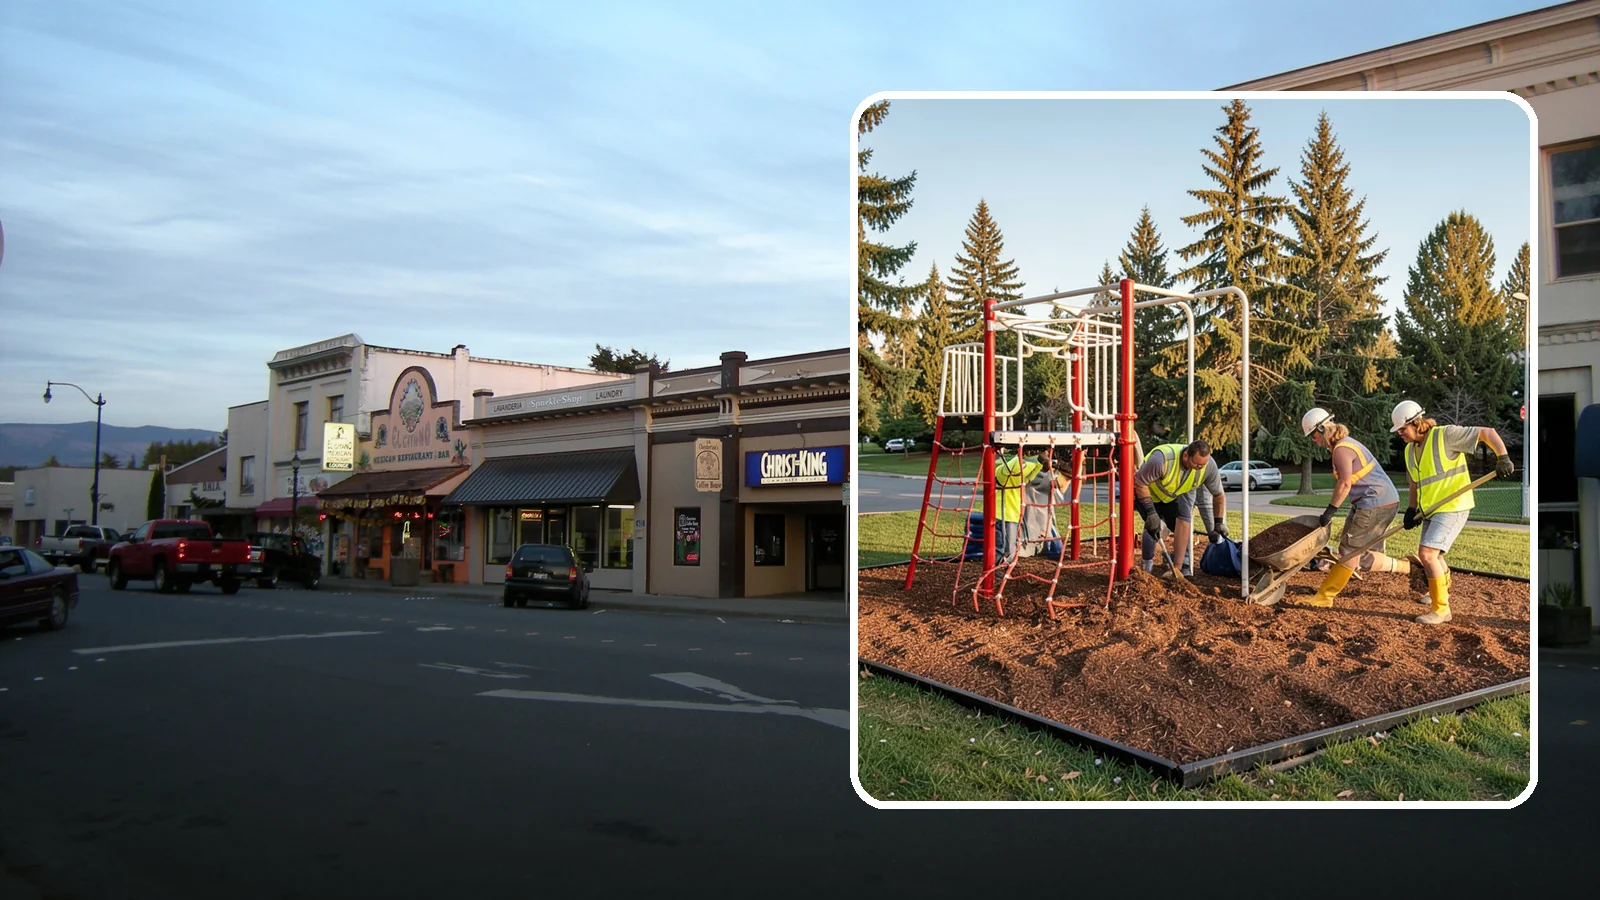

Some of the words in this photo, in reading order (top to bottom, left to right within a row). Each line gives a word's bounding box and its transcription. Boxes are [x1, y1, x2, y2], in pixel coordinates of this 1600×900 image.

[596, 389, 624, 400] LAUNDRY
[494, 402, 522, 412] LAVANDERIA
[374, 455, 396, 464] MEXICAN
[397, 451, 433, 463] RESTAURANT
[438, 449, 450, 459] BAR
[760, 452, 797, 478] CHRIST
[799, 450, 827, 477] KING
[696, 481, 709, 489] Coffee
[710, 480, 721, 489] House
